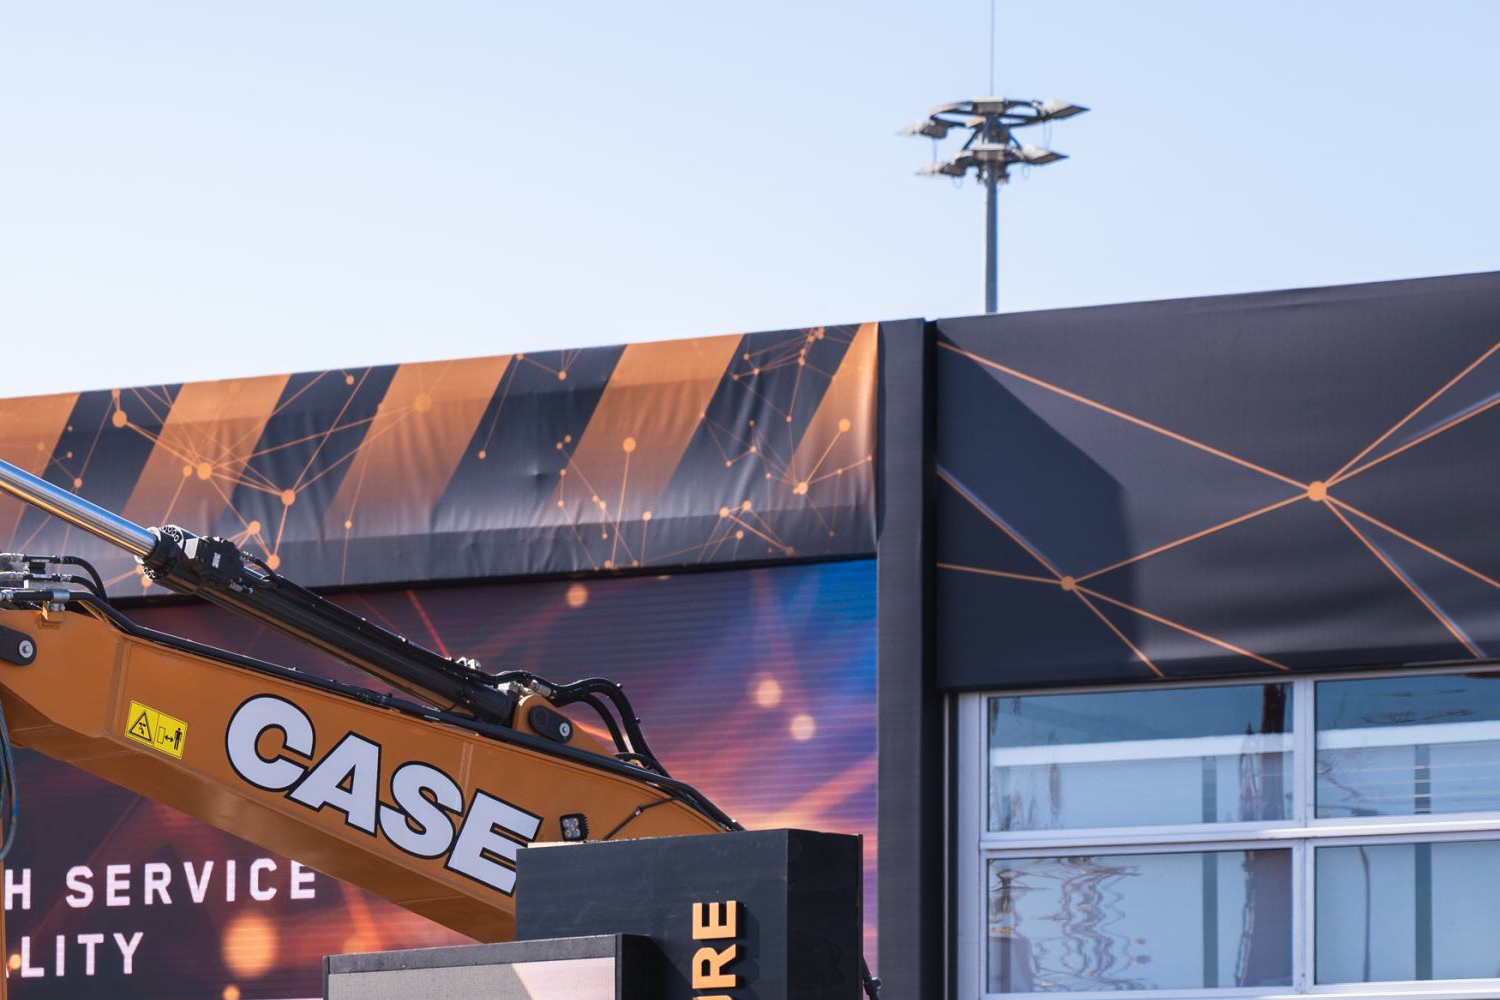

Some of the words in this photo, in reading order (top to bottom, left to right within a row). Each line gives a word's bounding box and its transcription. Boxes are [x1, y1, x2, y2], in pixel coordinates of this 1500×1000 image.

[225, 693, 544, 895] CASE
[65, 858, 316, 908] SERVICE
[6, 932, 144, 978] LITY
